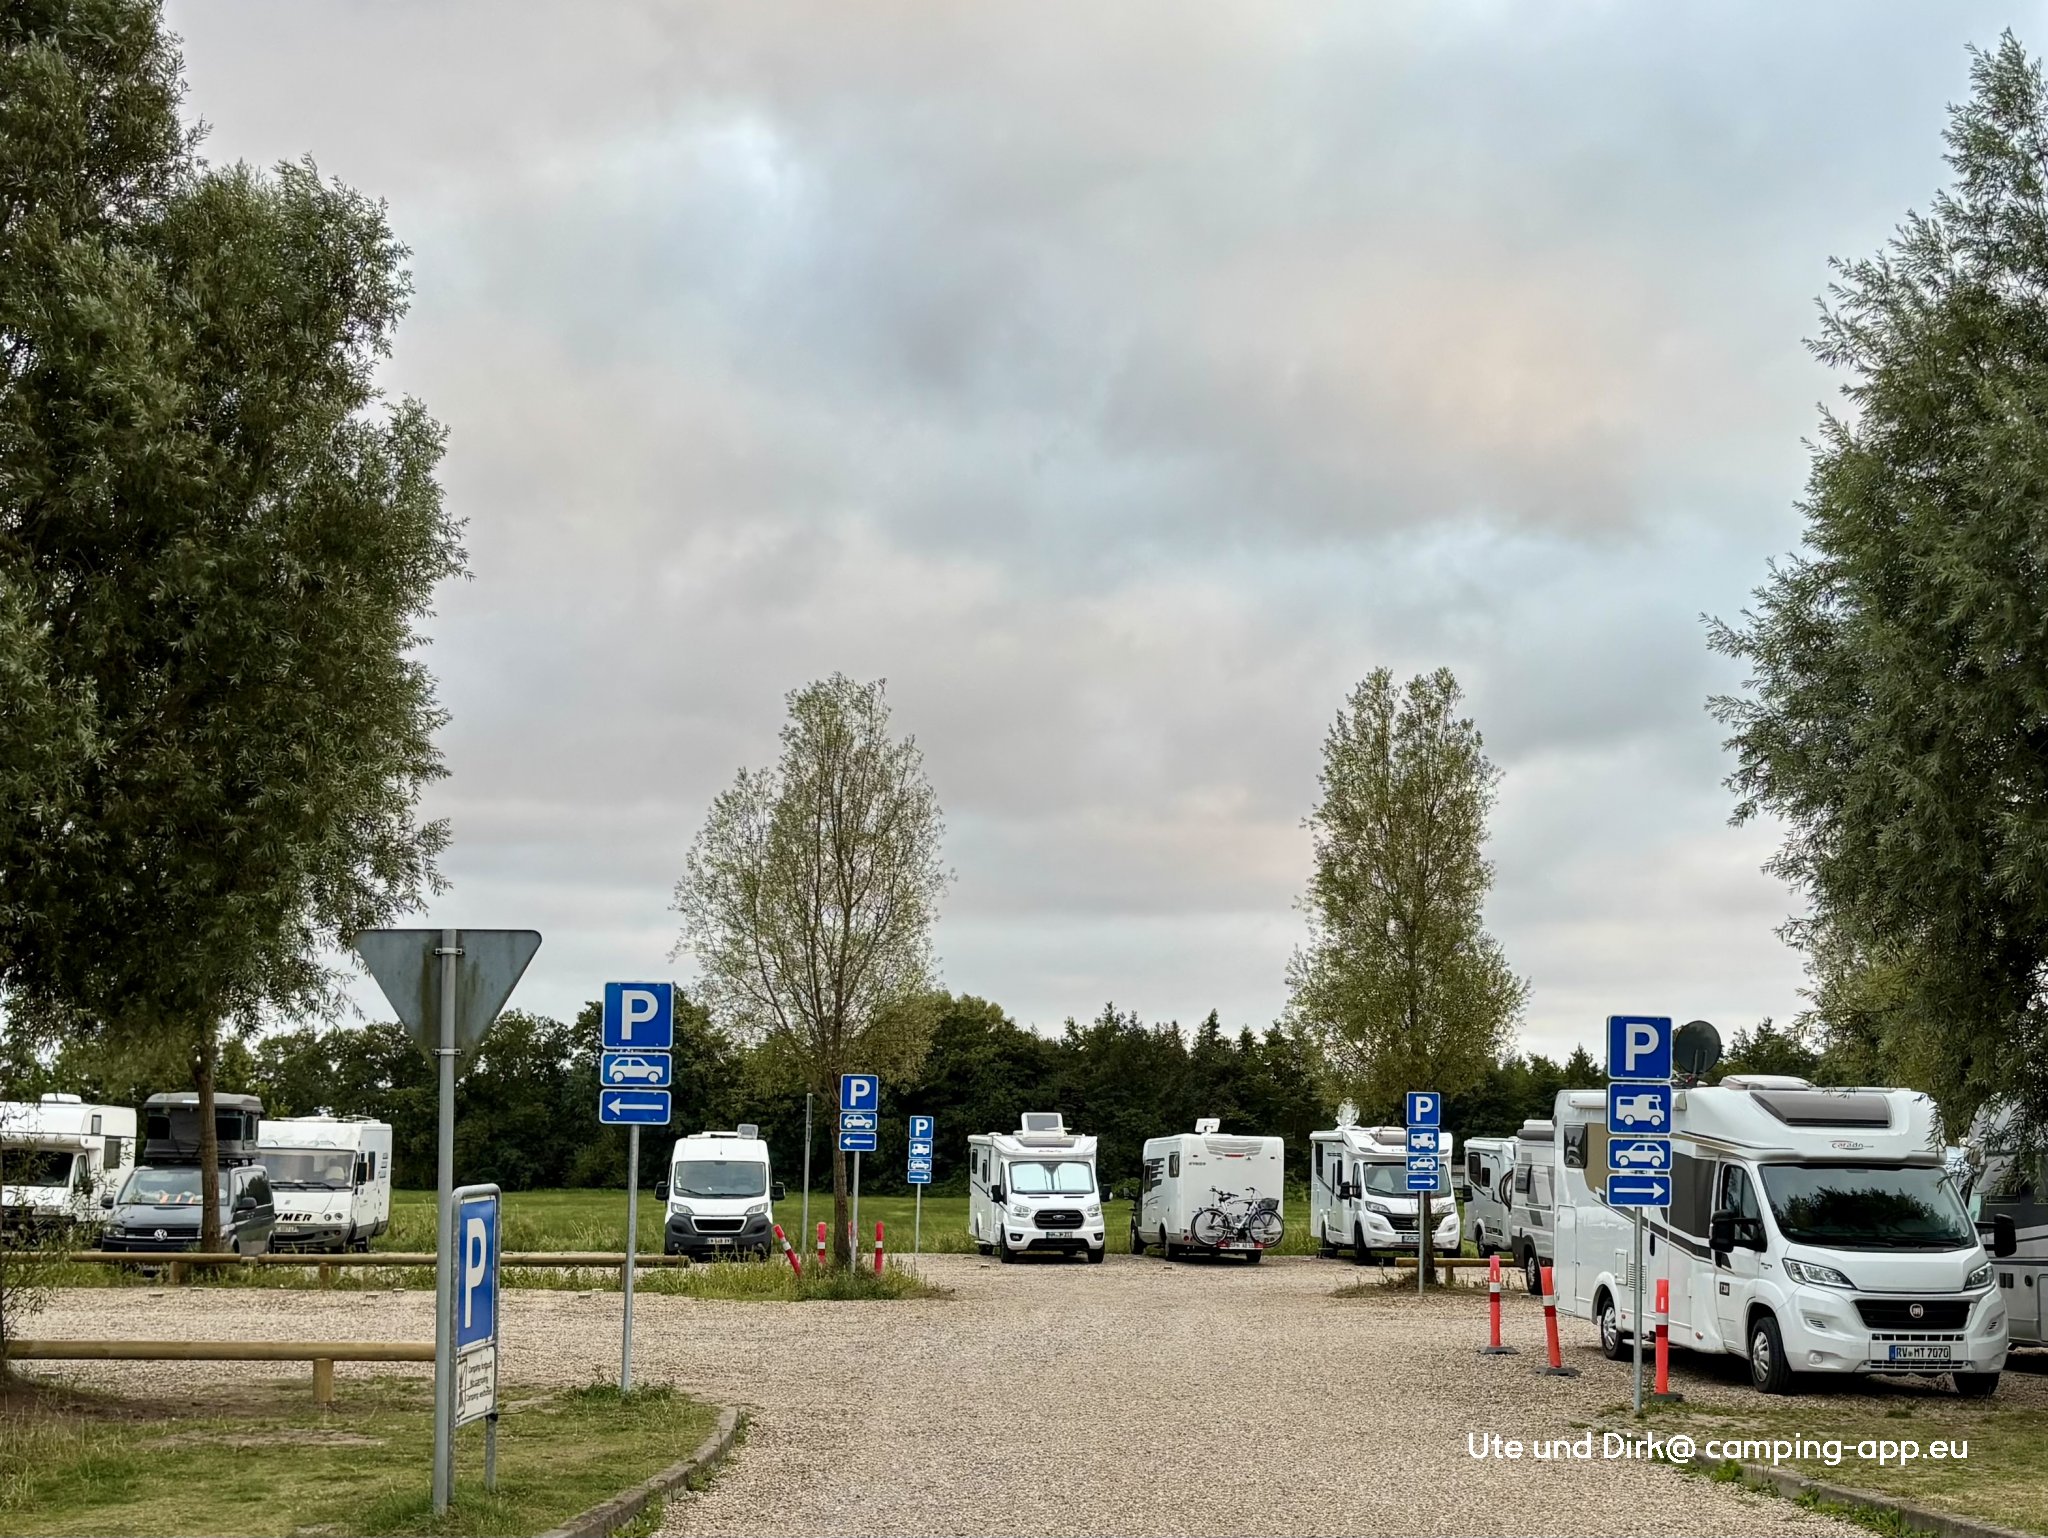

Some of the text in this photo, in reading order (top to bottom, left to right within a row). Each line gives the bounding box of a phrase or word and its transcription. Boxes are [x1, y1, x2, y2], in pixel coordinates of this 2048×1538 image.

[621, 989, 659, 1040] P
[1625, 1023, 1659, 1071] P
[850, 1079, 871, 1106] P
[1415, 1096, 1433, 1122] P
[915, 1118, 929, 1137] P
[274, 1212, 312, 1221] YMER
[464, 1217, 487, 1329] P
[1896, 1347, 1908, 1358] RV
[1927, 1347, 1949, 1358] 7070
